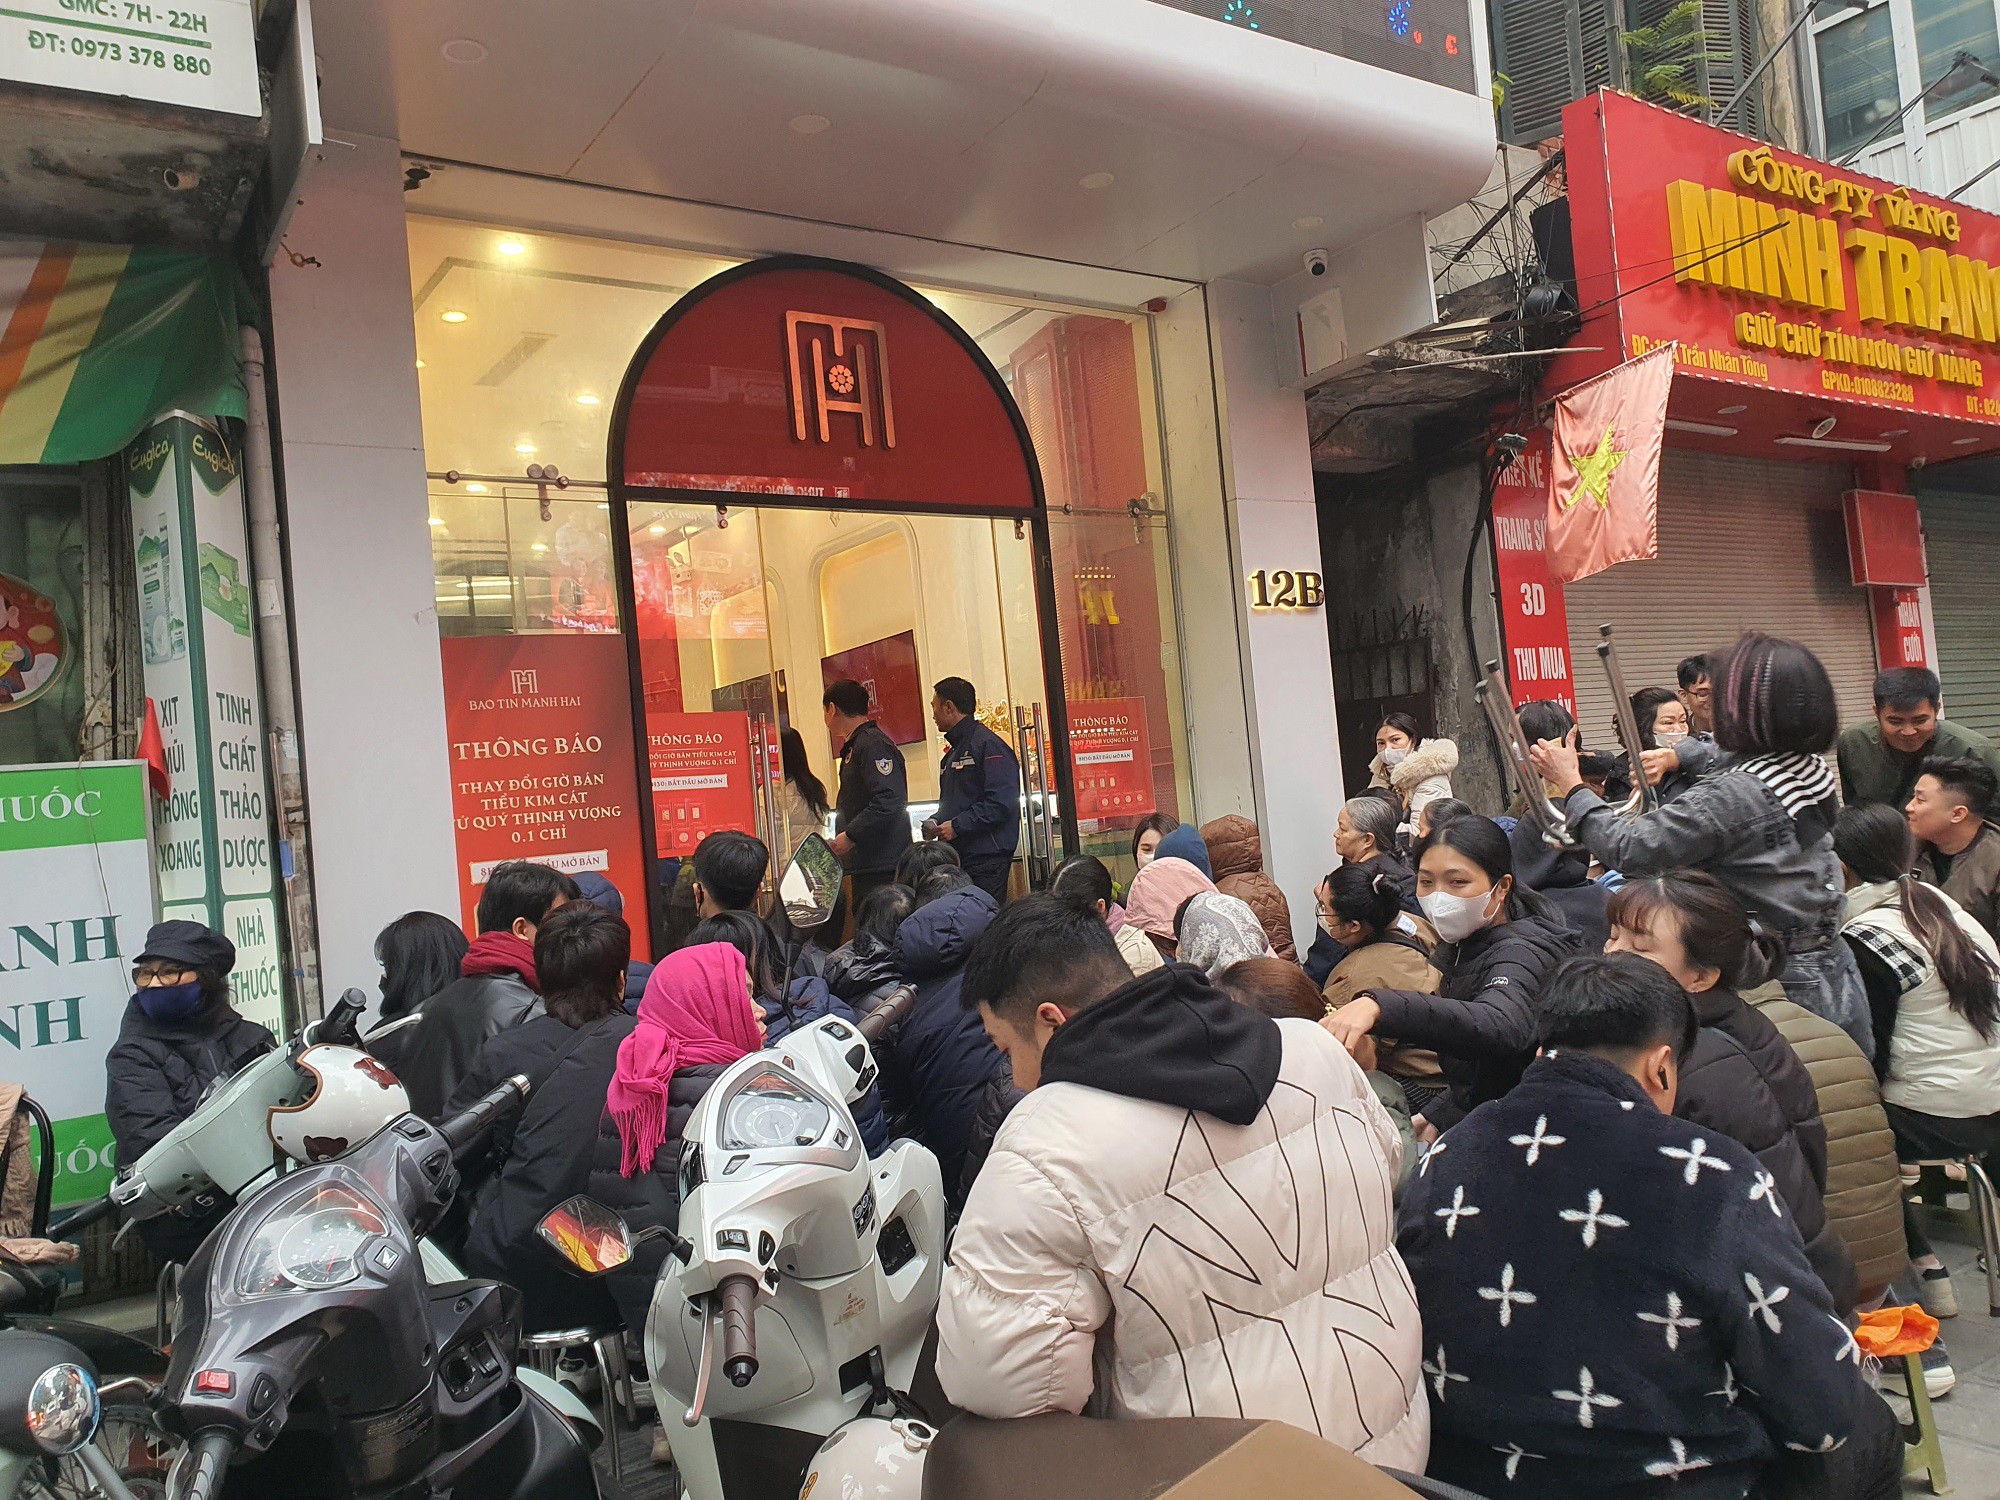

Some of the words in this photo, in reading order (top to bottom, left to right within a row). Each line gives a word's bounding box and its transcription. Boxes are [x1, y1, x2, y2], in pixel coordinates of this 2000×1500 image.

[123, 2, 152, 24] 7H
[168, 10, 208, 34] 22H
[28, 29, 66, 53] ĐT:
[71, 37, 122, 61] 0973
[129, 46, 166, 69] 378
[173, 53, 211, 76] 880
[1727, 146, 1827, 205] CÔNG
[1824, 179, 1875, 219] TY
[1874, 187, 1962, 242] VÀNG
[1666, 179, 1846, 312] MINH
[1844, 228, 2000, 344] TRAN
[1680, 342, 1707, 369] Trần
[1708, 349, 1740, 374] Nhân
[1740, 355, 1768, 382] Tông
[1735, 311, 1777, 350] GIỮ
[1776, 321, 1821, 358] CHỮ
[1821, 327, 1859, 364] TÍN
[1858, 337, 1901, 373] HƠN
[1900, 345, 1934, 378] GIỮ
[1936, 350, 1983, 387] VÀNG
[130, 439, 170, 471] Eugica
[192, 434, 236, 476] Eugica
[1496, 517, 1533, 551] TRANG
[1247, 569, 1325, 610] 12B
[1520, 583, 1546, 616] 3D
[1514, 647, 1537, 681] THU
[1539, 647, 1567, 681] MUA
[160, 696, 178, 734] XỊT
[216, 692, 252, 726] TINH
[469, 699, 495, 711] BAO
[497, 698, 519, 709] TIN
[521, 697, 558, 708] MANH
[560, 696, 581, 707] HAI
[1073, 716, 1107, 727] THÔNG
[1109, 714, 1128, 725] BÁO
[219, 735, 256, 772] CHẤT
[453, 736, 548, 760] THÔNG
[554, 732, 602, 755] BÁO
[648, 733, 692, 746] HÔNG
[695, 731, 722, 744] BÁO
[458, 780, 505, 794] THAY
[509, 774, 538, 791] ĐỔI
[541, 773, 570, 788] GIỜ
[573, 772, 604, 786] BÁN
[220, 783, 262, 820] THẢO
[481, 792, 520, 811] TIỂU
[524, 794, 555, 807] KIM
[559, 790, 588, 804] CÁT
[453, 815, 469, 830] Ứ
[472, 811, 509, 831] QUÝ
[512, 809, 565, 827] THỊNH
[568, 805, 622, 821] VƯỢNG
[511, 830, 534, 843] 0.1
[540, 824, 567, 840] CHỈ
[159, 839, 201, 872] XOANG
[223, 835, 267, 875] DƯỢC
[579, 855, 600, 866] BÁN
[0, 915, 125, 972] NH
[236, 908, 266, 948] NHÀ
[231, 956, 277, 1004] THUỐC
